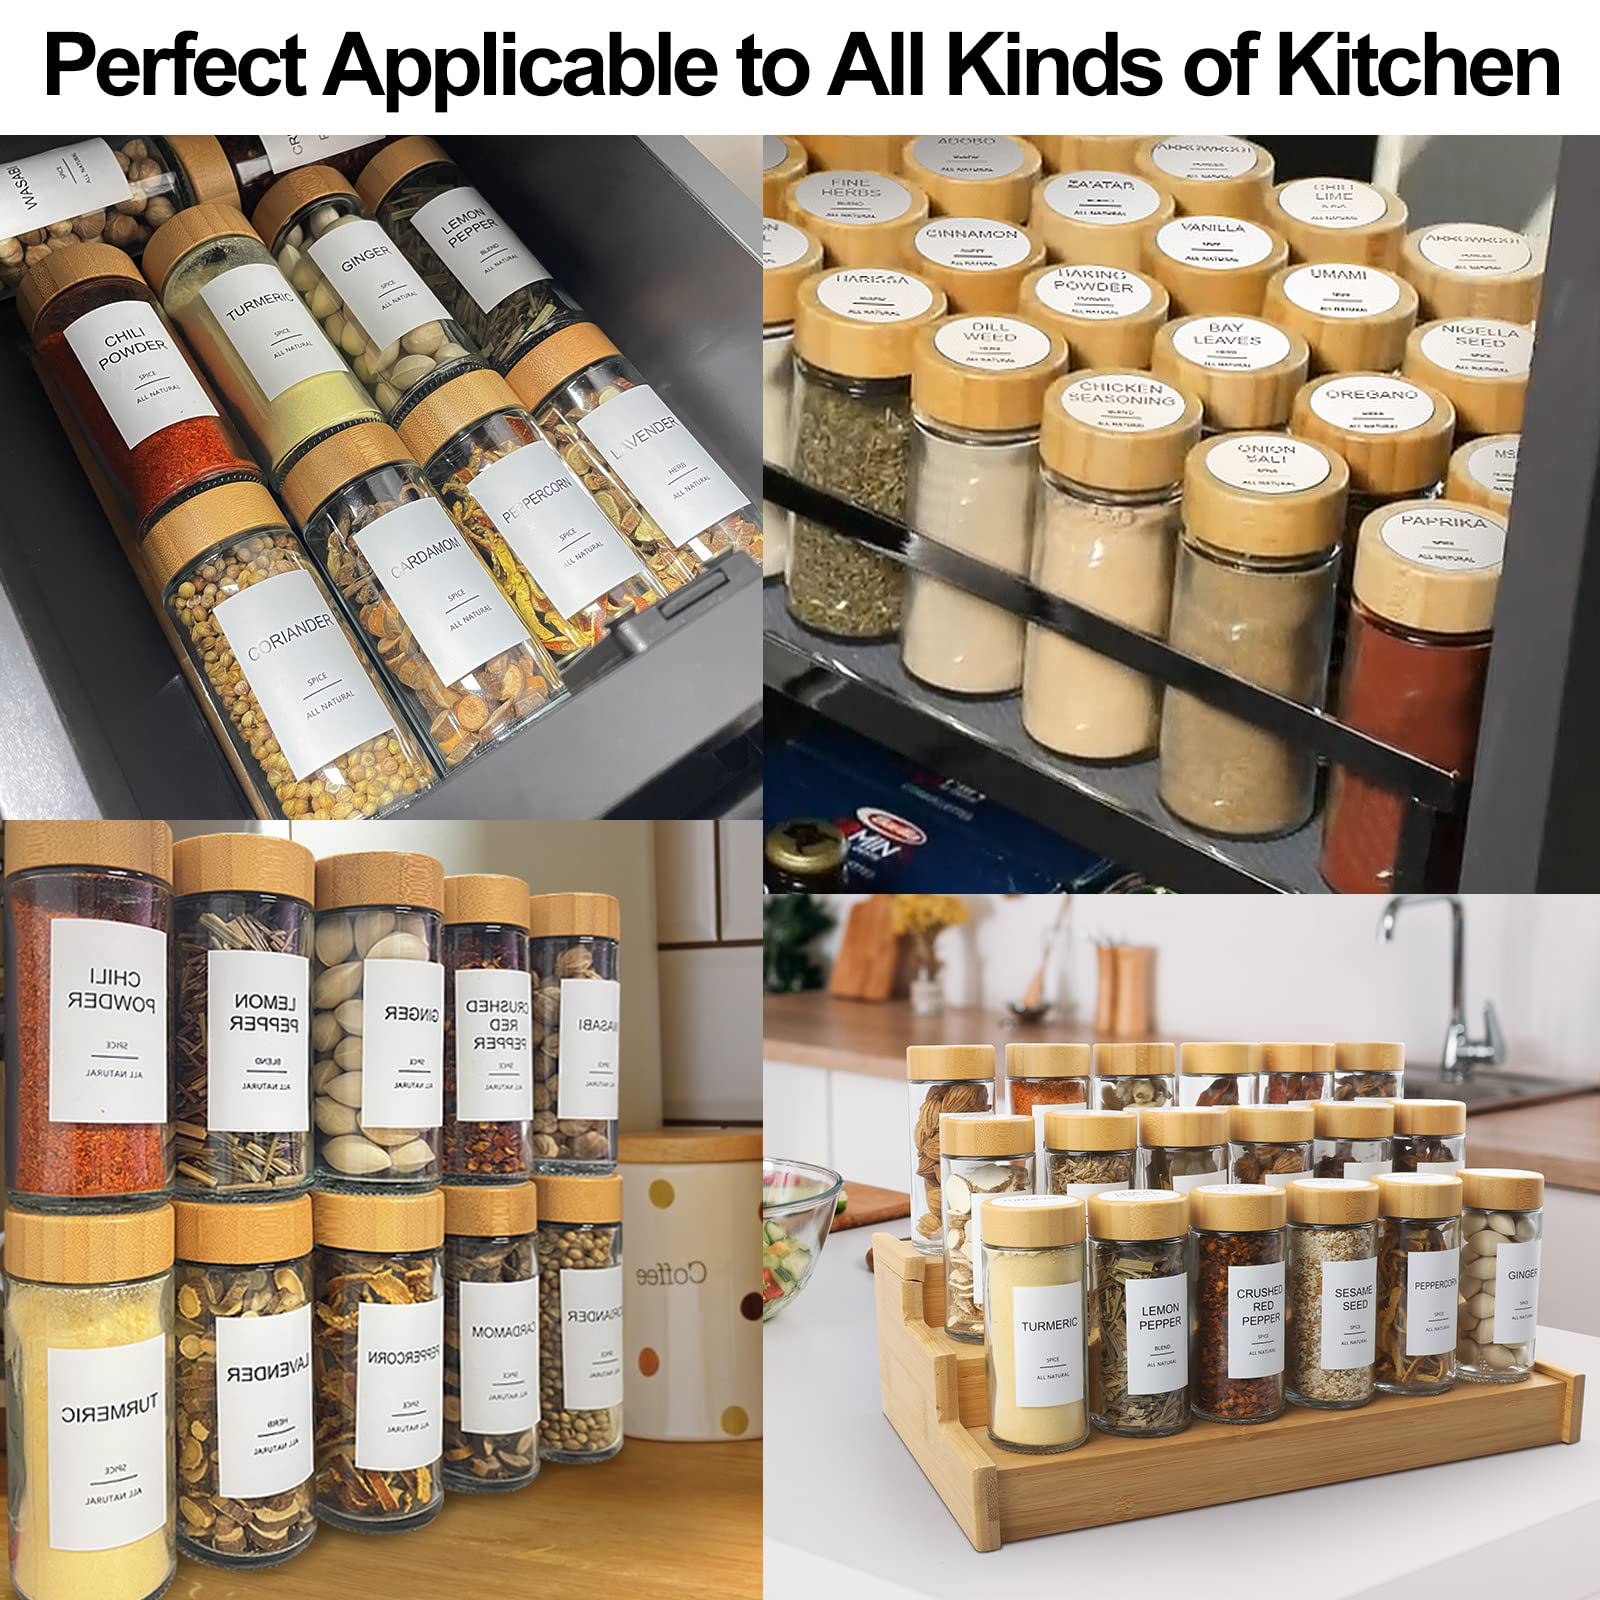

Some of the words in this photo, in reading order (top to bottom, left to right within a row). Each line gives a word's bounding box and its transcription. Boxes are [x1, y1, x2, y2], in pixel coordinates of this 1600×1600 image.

[7, 165, 38, 210] WASABI
[831, 179, 870, 187] FINE
[822, 188, 881, 197] HERBS
[442, 208, 485, 234] LEMON
[1181, 223, 1245, 232] VANILLA
[448, 218, 498, 248] PEPPER
[926, 230, 1018, 238] CINNAMON
[480, 243, 499, 255] BLEND
[341, 246, 392, 272] GINGER
[484, 266, 494, 274] ALL
[494, 254, 518, 267] NATURAL
[1311, 269, 1366, 280] UMAMI
[380, 280, 395, 289] SPICE
[1054, 281, 1134, 293] POWDER
[392, 291, 417, 303] NATURAL
[226, 293, 294, 320] TURMERIC
[274, 328, 290, 337] SPICE
[973, 322, 1010, 332] DILL
[1209, 323, 1244, 332] BAY
[1442, 325, 1520, 338] NIGELLA
[105, 327, 145, 347] CHILI
[963, 332, 1017, 342] WEED
[1194, 336, 1261, 345] LEAVES
[1456, 337, 1506, 348] SEED
[286, 341, 313, 353] NATURAL
[99, 340, 168, 371] POWDER
[138, 371, 156, 380] SPICE
[1080, 381, 1162, 394] CHICKEN
[136, 395, 148, 404] ALL
[150, 385, 181, 397] NATURAL
[1069, 392, 1175, 406] SEASONING
[1326, 390, 1418, 399] OREGANO
[610, 416, 679, 459] LAVENDER
[1238, 444, 1295, 454] ONION
[668, 462, 687, 475] HERB
[673, 491, 685, 500] ALL
[684, 475, 711, 492] NATURAL
[502, 477, 572, 524] PEPERCORN
[1402, 516, 1488, 528] PAPRIKA
[559, 528, 577, 541] SPICE
[391, 537, 461, 579] CARDAMOM
[564, 558, 576, 568] ALL
[575, 541, 604, 560] NATURAL
[1434, 555, 1475, 563] NATURAL
[448, 588, 466, 602] SPICE
[450, 621, 463, 631] ALL
[463, 605, 492, 623] NATURAL
[248, 614, 335, 661] CORIANDER
[307, 672, 328, 687] SPICE
[306, 709, 321, 720] ALL
[321, 690, 355, 711] NATURAL
[1237, 1285, 1282, 1298] CRUSHED
[1335, 1285, 1372, 1298] SESAME
[1142, 1303, 1179, 1316] LEMON
[1253, 1301, 1274, 1312] RED
[1343, 1300, 1368, 1311] SEED
[1022, 1317, 1078, 1331] TURMERIC
[1140, 1316, 1181, 1330] PEPPER
[1242, 1312, 1280, 1326] PEPPER
